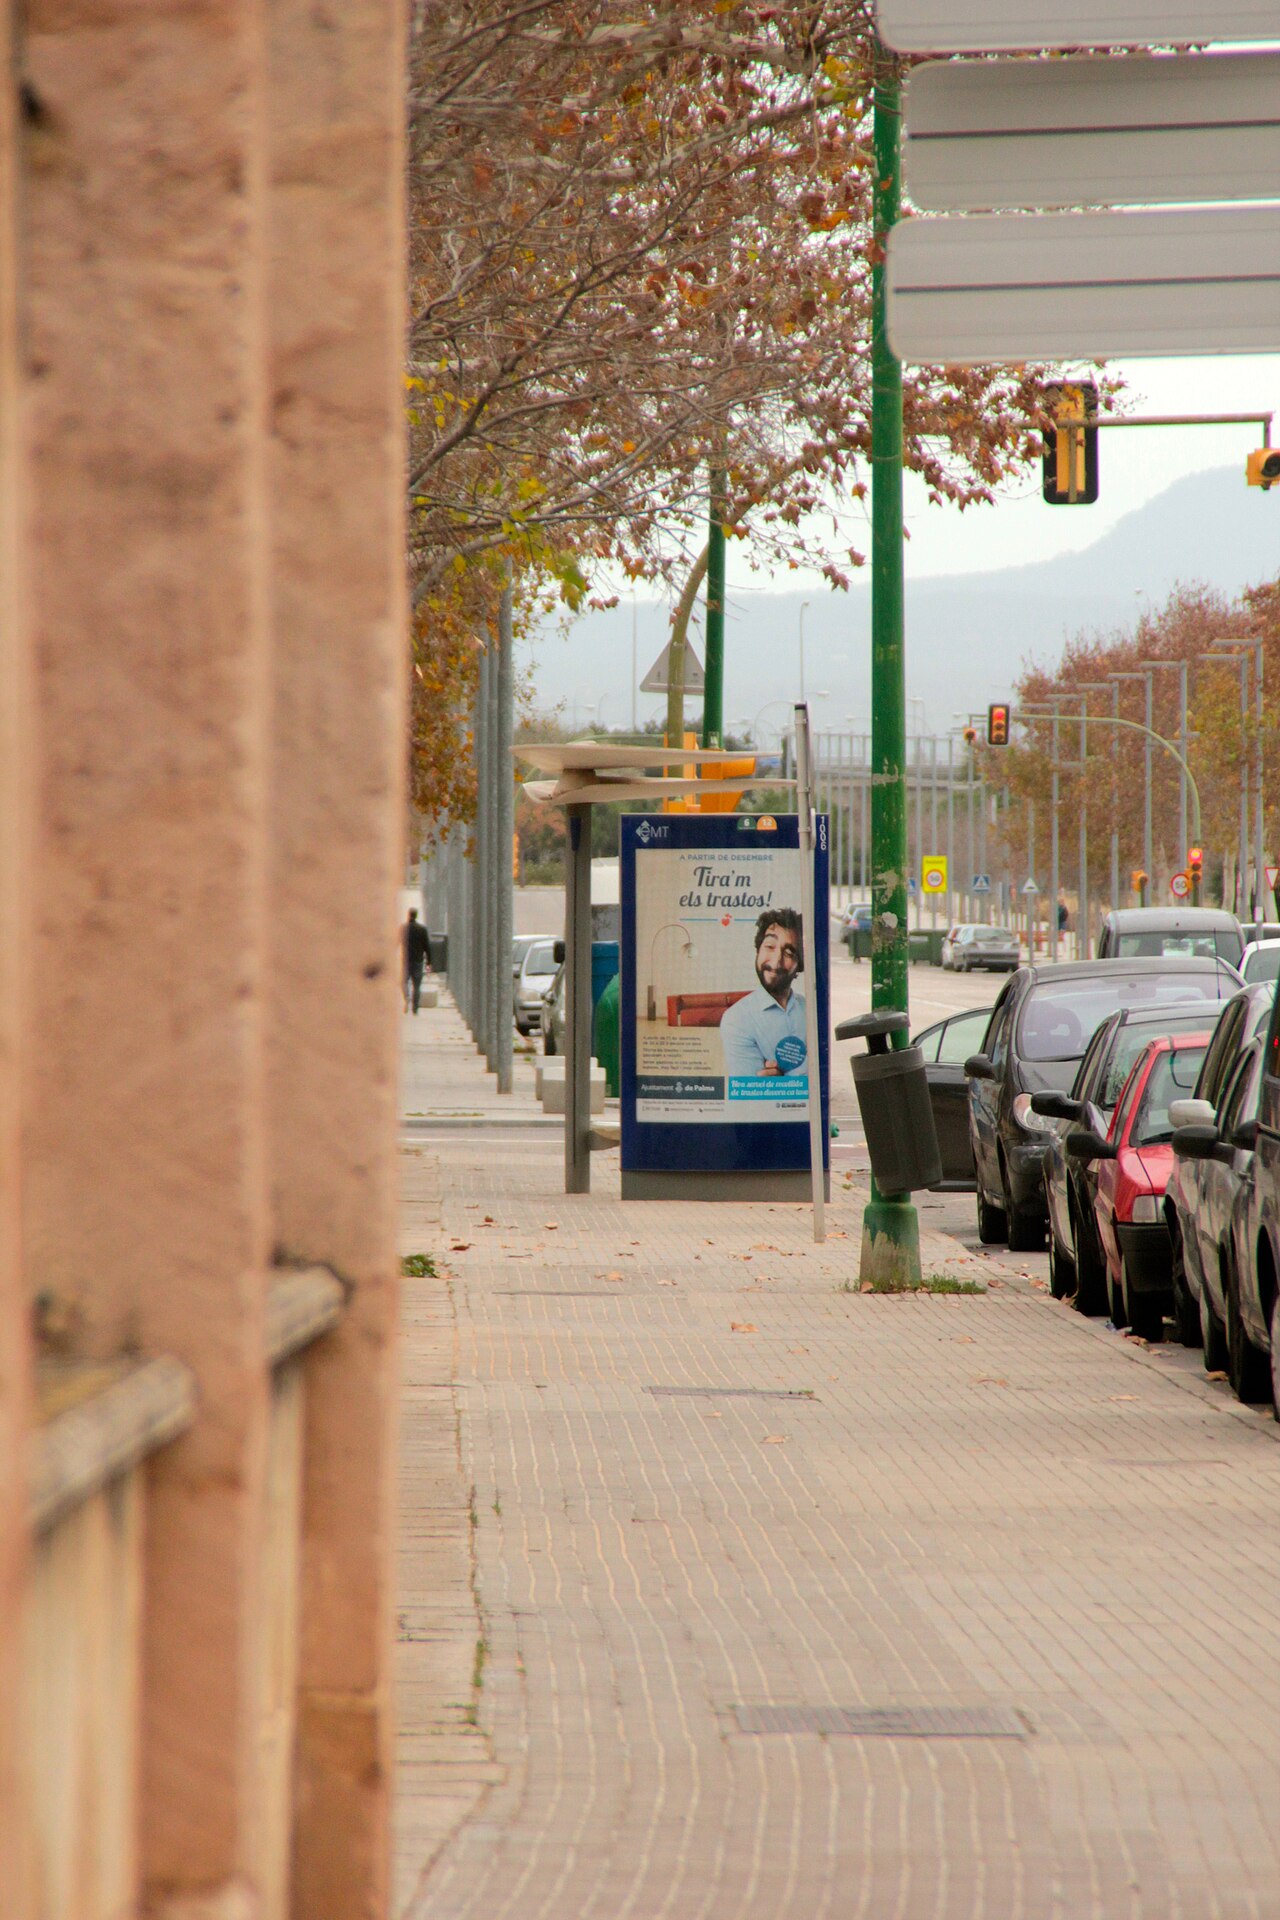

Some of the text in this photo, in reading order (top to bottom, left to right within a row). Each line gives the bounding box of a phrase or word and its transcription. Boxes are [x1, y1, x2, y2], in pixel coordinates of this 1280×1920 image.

[743, 818, 751, 827] 6
[762, 818, 773, 827] 12
[819, 816, 827, 850] 1006
[693, 866, 752, 887] Tira'm
[679, 891, 773, 908] els trastos!
[684, 1084, 694, 1092] de
[694, 1084, 716, 1092] Palma
